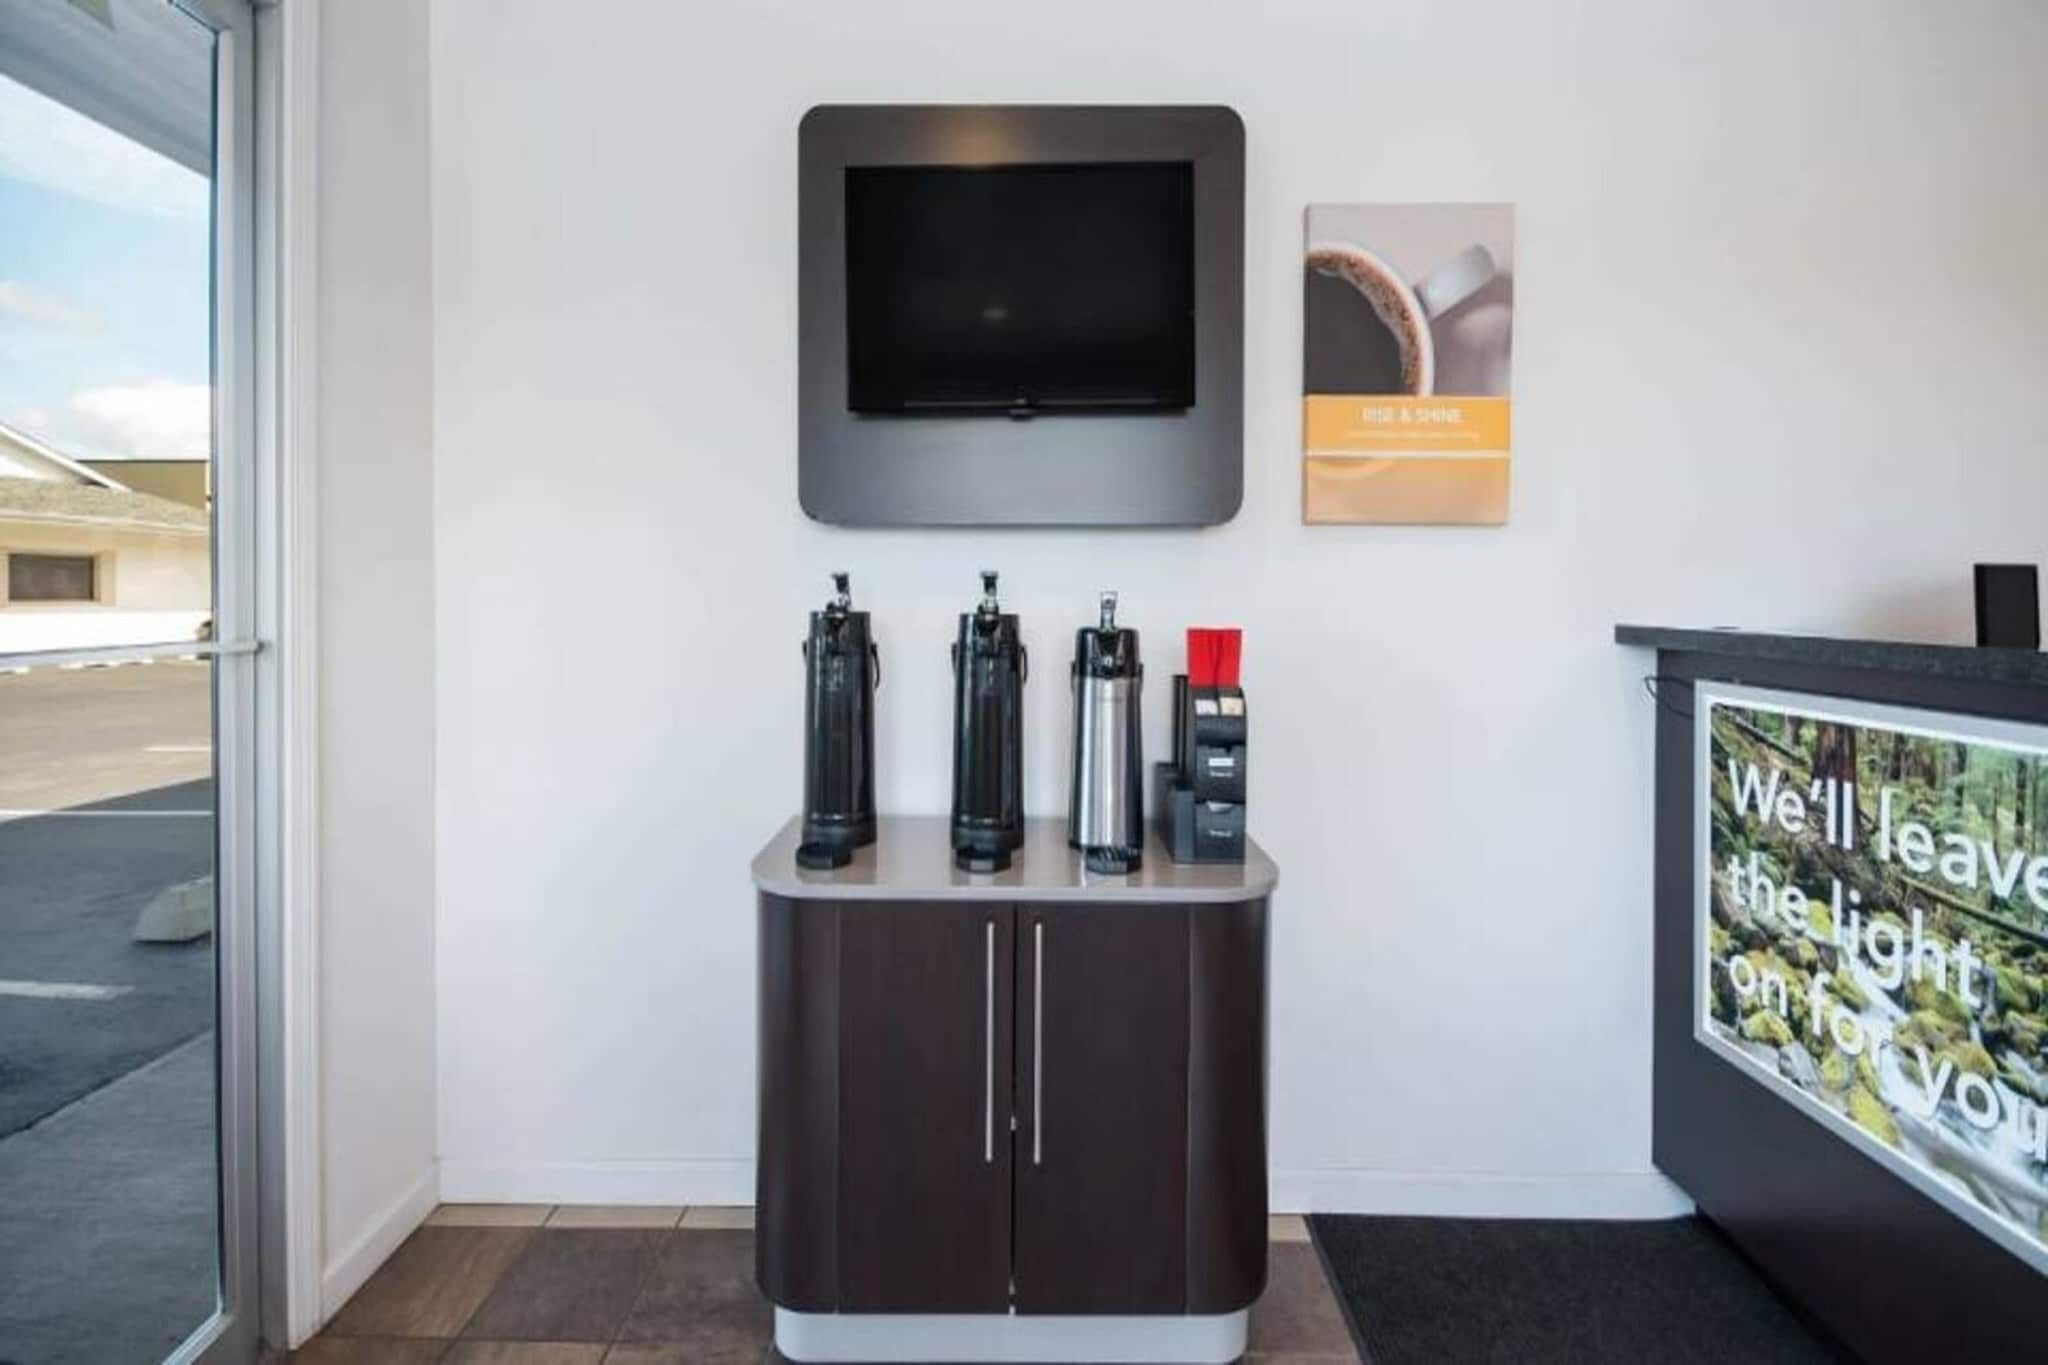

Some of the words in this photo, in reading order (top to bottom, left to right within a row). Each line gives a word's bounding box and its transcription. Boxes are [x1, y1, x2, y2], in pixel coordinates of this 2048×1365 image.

[1727, 757, 1853, 851] We'll
[1881, 785, 2048, 912] leave
[1727, 850, 1809, 927] the
[1832, 877, 1982, 1009] light
[1729, 956, 1787, 1017] on
